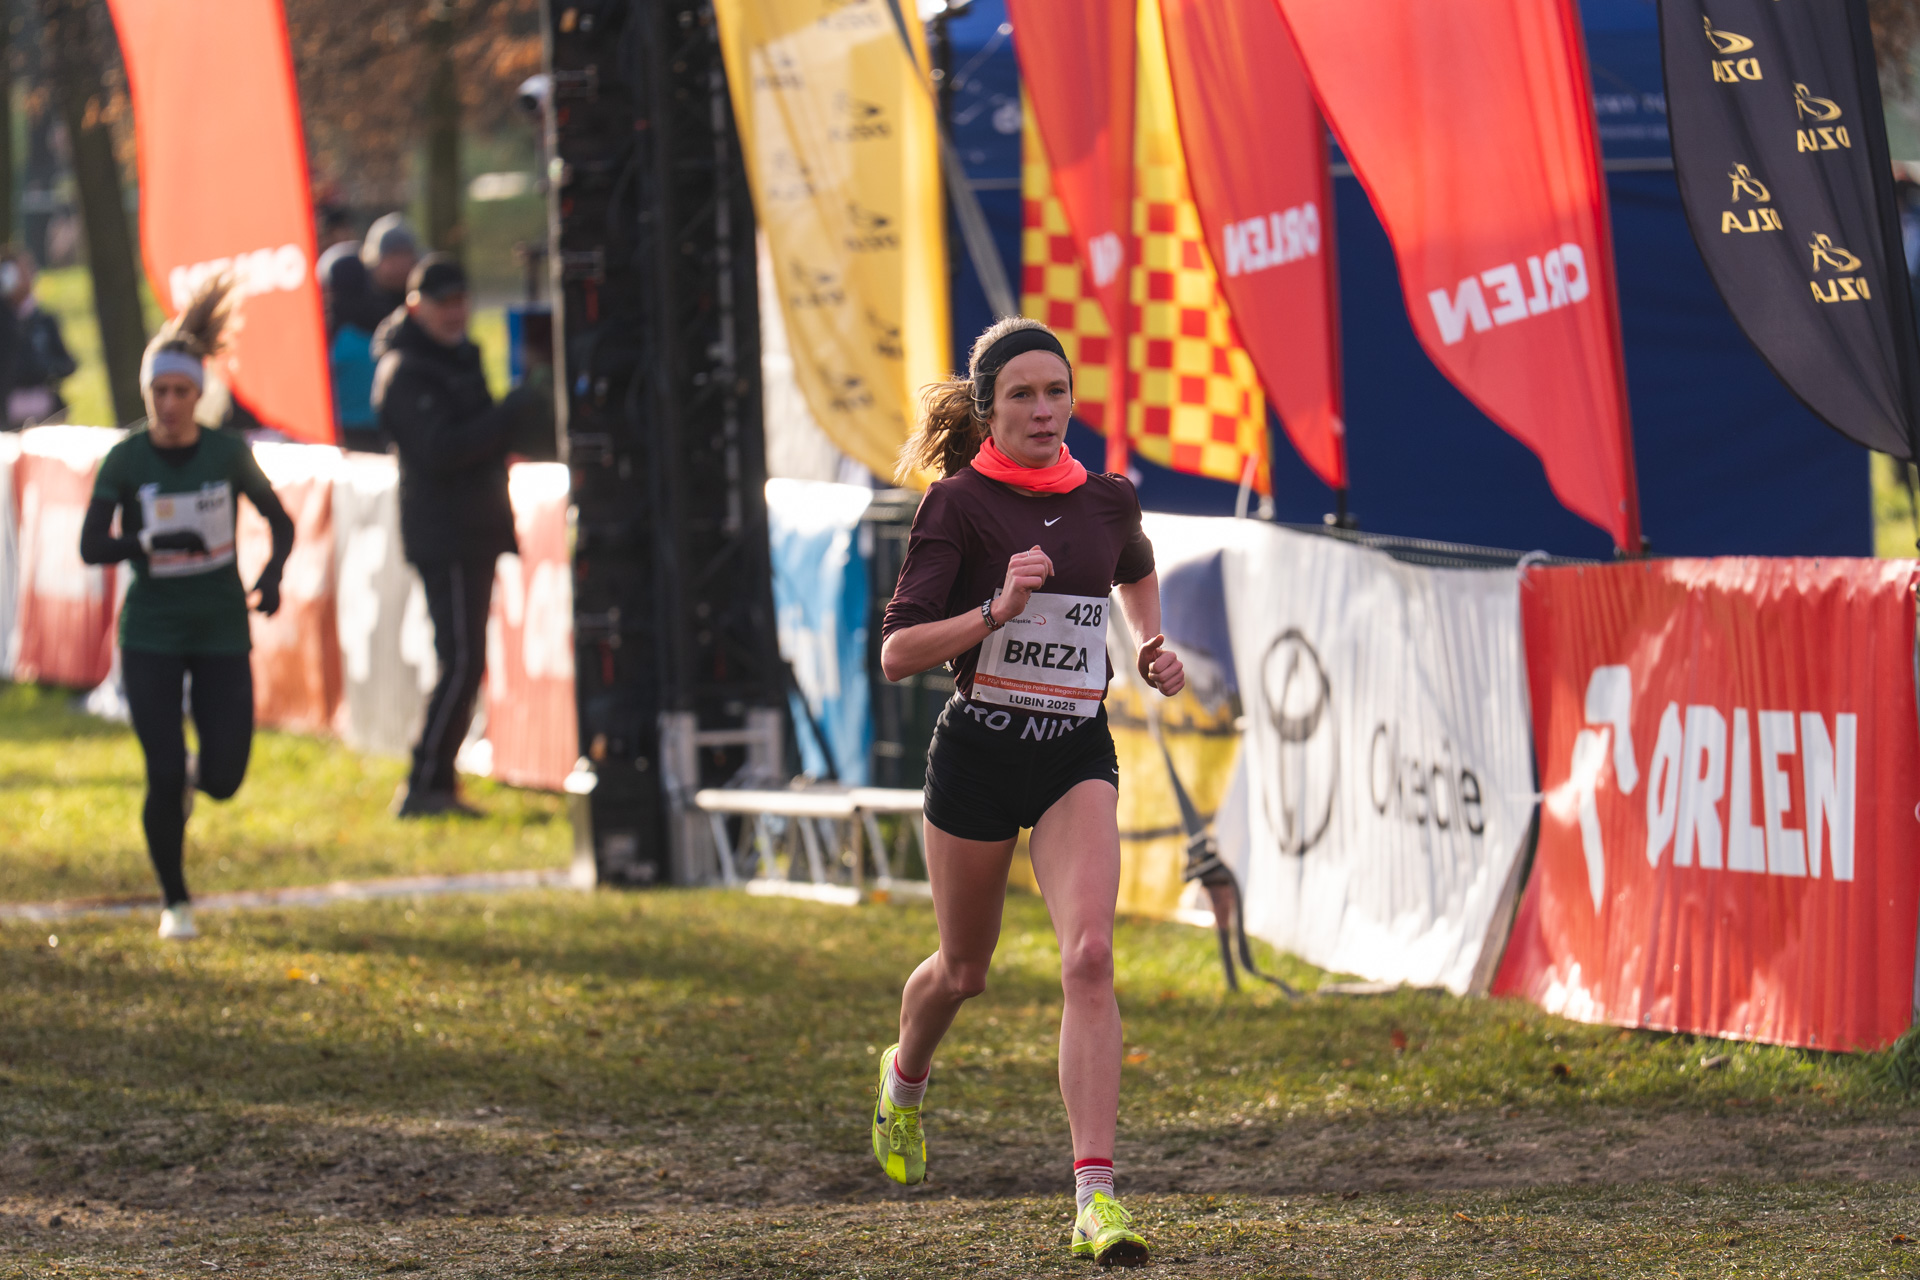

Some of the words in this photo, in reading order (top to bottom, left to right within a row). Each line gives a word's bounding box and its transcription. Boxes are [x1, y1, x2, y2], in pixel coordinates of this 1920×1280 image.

[1065, 603, 1103, 627] 428
[1003, 640, 1089, 673] BREZA
[1009, 695, 1044, 708] LUBIN
[1047, 700, 1076, 712] 2025
[1646, 701, 1857, 882] ORLEN
